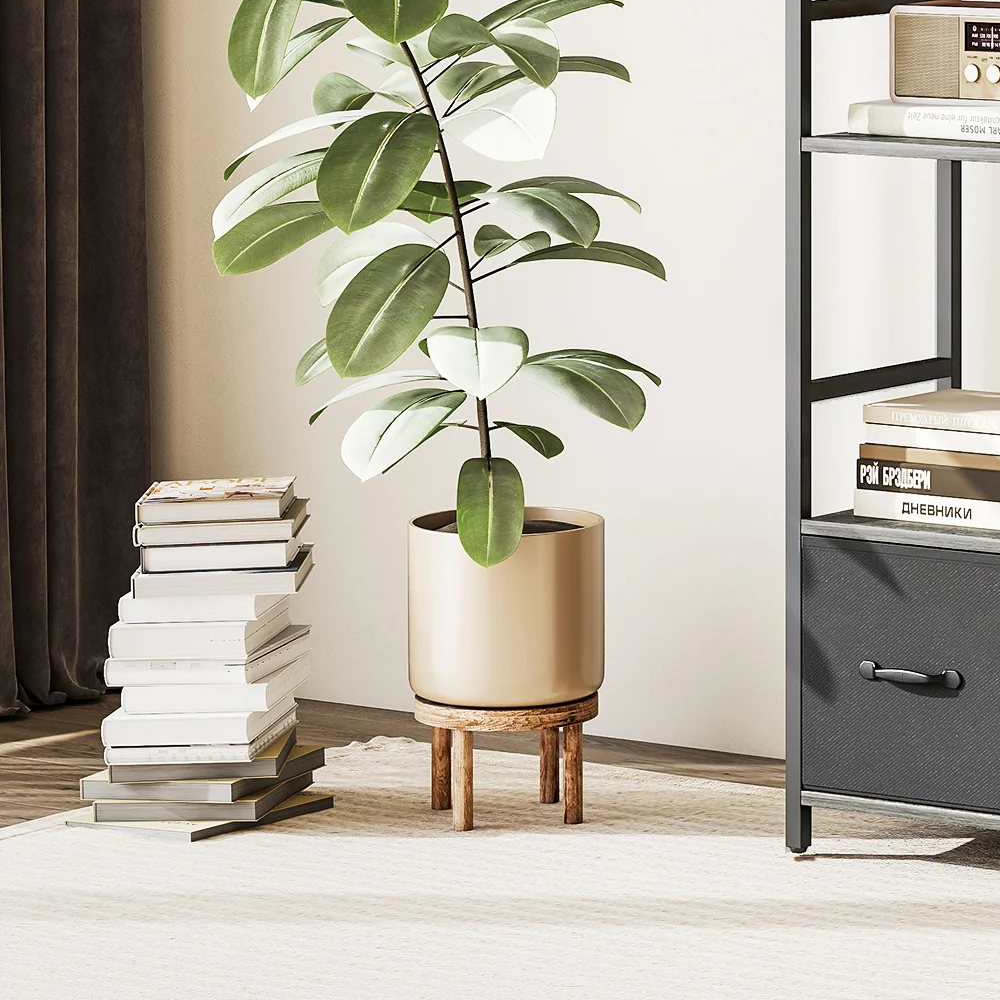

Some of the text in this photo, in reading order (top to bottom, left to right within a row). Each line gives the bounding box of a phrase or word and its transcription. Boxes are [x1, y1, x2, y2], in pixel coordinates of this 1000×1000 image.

[960, 124, 986, 134] MOSER
[860, 461, 931, 490] РЭЙ БРЭДБЕРИ
[901, 501, 972, 520] ДНЕВНИКИ
